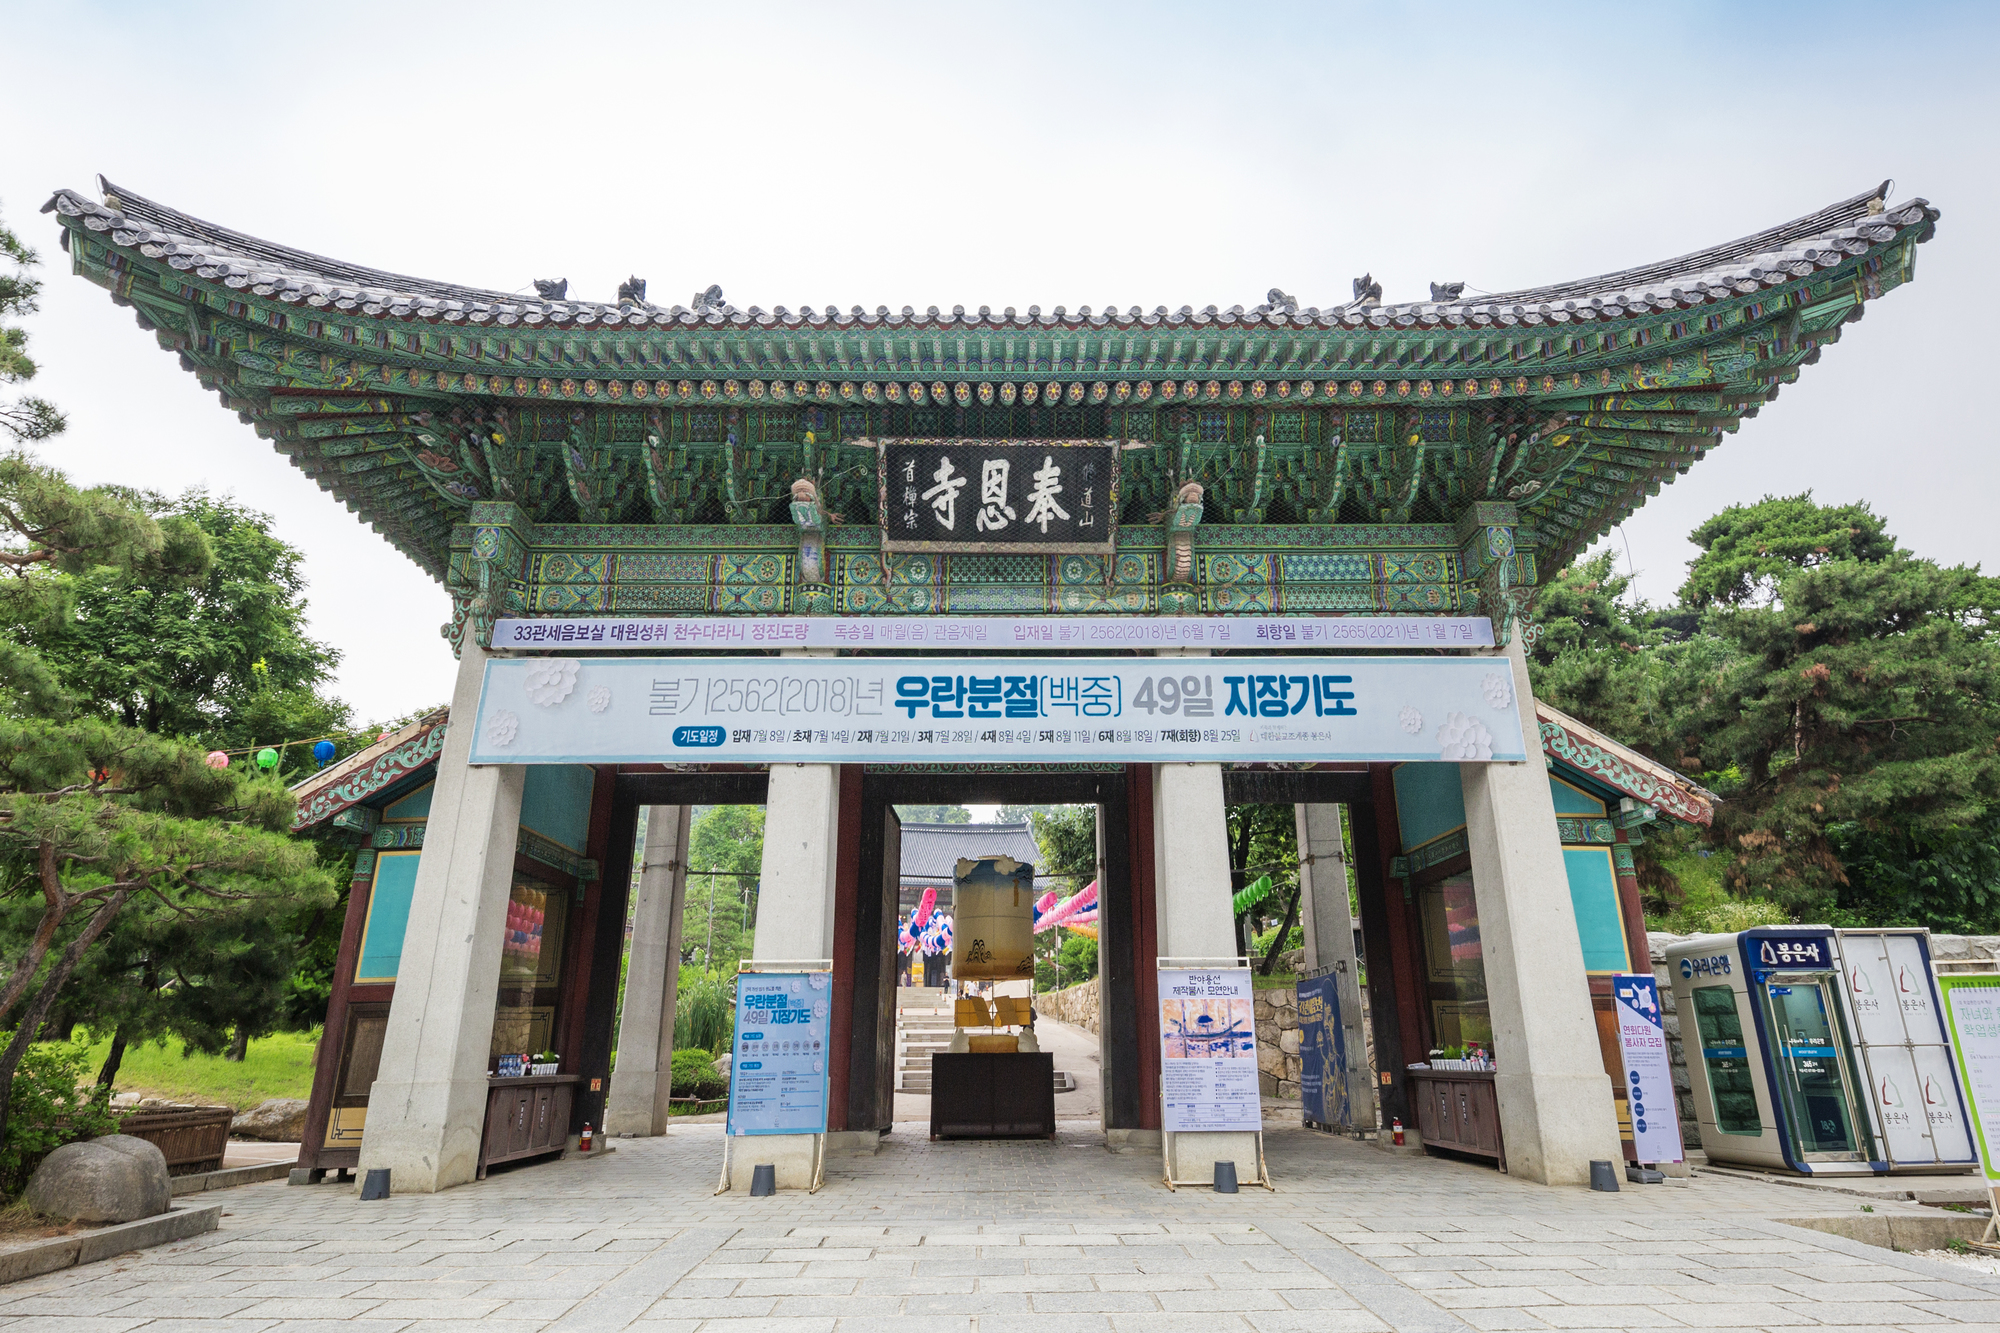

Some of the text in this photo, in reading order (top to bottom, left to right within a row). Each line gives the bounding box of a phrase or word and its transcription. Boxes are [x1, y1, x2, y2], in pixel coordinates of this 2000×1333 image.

[514, 623, 1474, 642] 33관세음보살 대원성취 천수다라니 정진도량 독송일 매월(음) 관음재일 입재일 불기 2562(2018)년 6월 7일 회향일 불기 2565(2021)년 1월 7일
[894, 675, 1122, 719] 우란분절(백중)
[1132, 675, 1215, 718] 49일
[1223, 674, 1358, 718] 지장기도
[680, 729, 719, 743] 기도일정
[732, 729, 751, 743] 입재
[753, 729, 767, 743] 7월
[769, 729, 785, 743] 8일
[792, 729, 812, 743] 초재
[813, 729, 828, 743] 7월
[831, 729, 849, 743] 14일
[857, 729, 873, 743] 2재
[874, 729, 889, 743] 7월
[891, 730, 910, 743] 21일
[917, 729, 933, 743] 3재
[935, 729, 950, 743] 7월
[952, 730, 973, 743] 28일
[980, 729, 996, 743] 4재
[998, 729, 1014, 743] 8월
[1016, 730, 1031, 743] 4일
[1039, 729, 1054, 743] 5재
[1056, 729, 1071, 743] 8월
[1074, 730, 1090, 743] 11일
[1098, 729, 1114, 743] 6재
[1116, 729, 1132, 743] 8월
[1134, 729, 1153, 743] 18일
[1160, 729, 1201, 743] 7재(회향)
[1203, 729, 1219, 743] 8월
[1221, 729, 1241, 743] 25일
[1776, 942, 1819, 963] 봉은사
[1692, 954, 1732, 978] 우리은행
[1188, 974, 1221, 985] 반야용선
[1207, 985, 1239, 996] 모연안내
[1855, 999, 1879, 1011] 봉은사
[1902, 999, 1926, 1011] 봉은사
[743, 1009, 811, 1024] 49일 지장기도
[1959, 1007, 1993, 1021] 자녀와
[1624, 1037, 1663, 1048] 봉사자 모집
[1884, 1112, 1909, 1125] 봉은사
[1928, 1111, 1953, 1124] 봉은사
